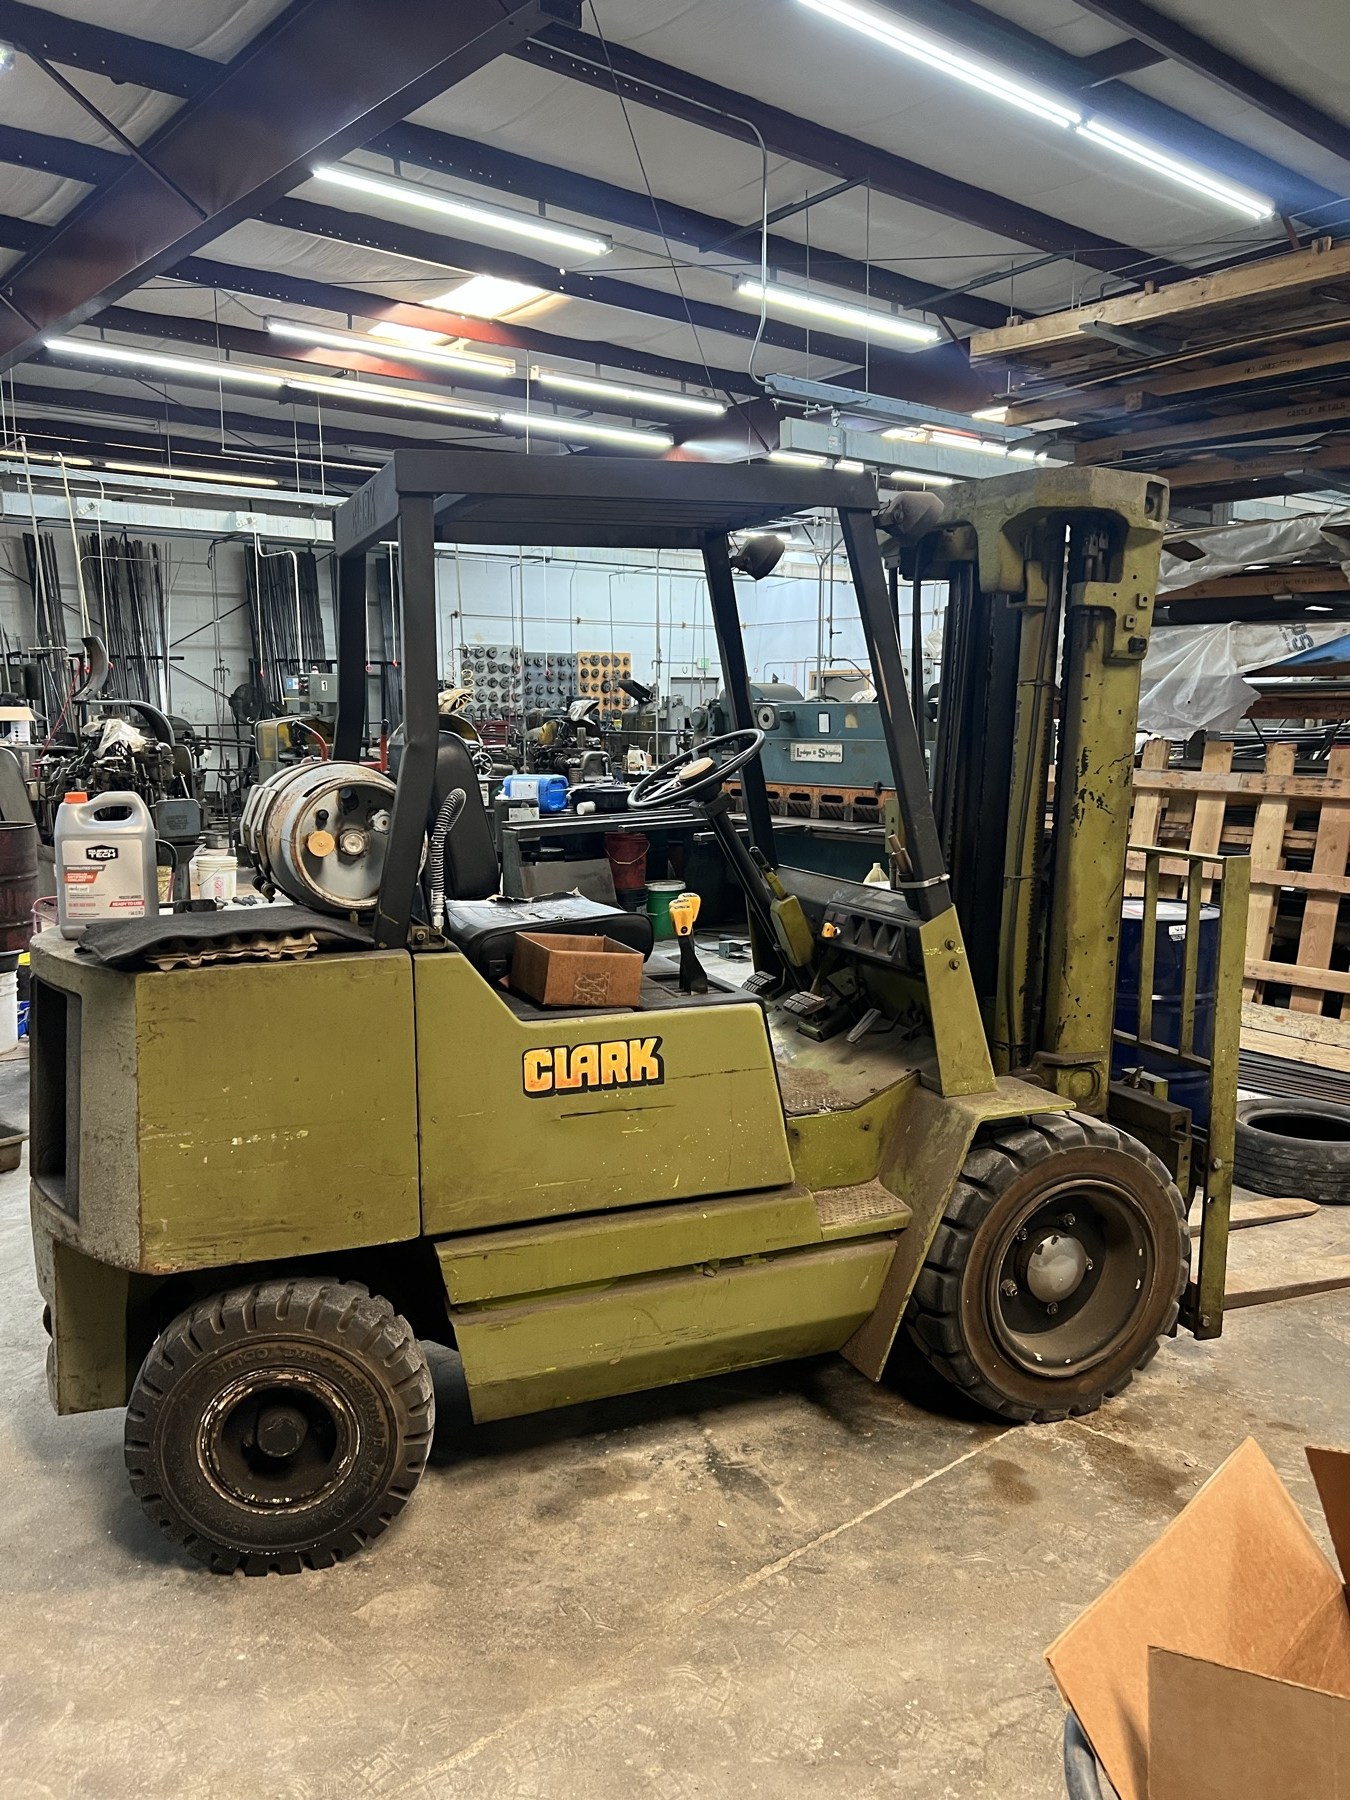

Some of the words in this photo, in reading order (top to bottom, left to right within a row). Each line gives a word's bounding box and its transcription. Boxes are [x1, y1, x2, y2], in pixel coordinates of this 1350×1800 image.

[1286, 406, 1314, 418] CASTLE
[1318, 402, 1347, 413] METALS
[523, 1037, 663, 1097] CLARK
